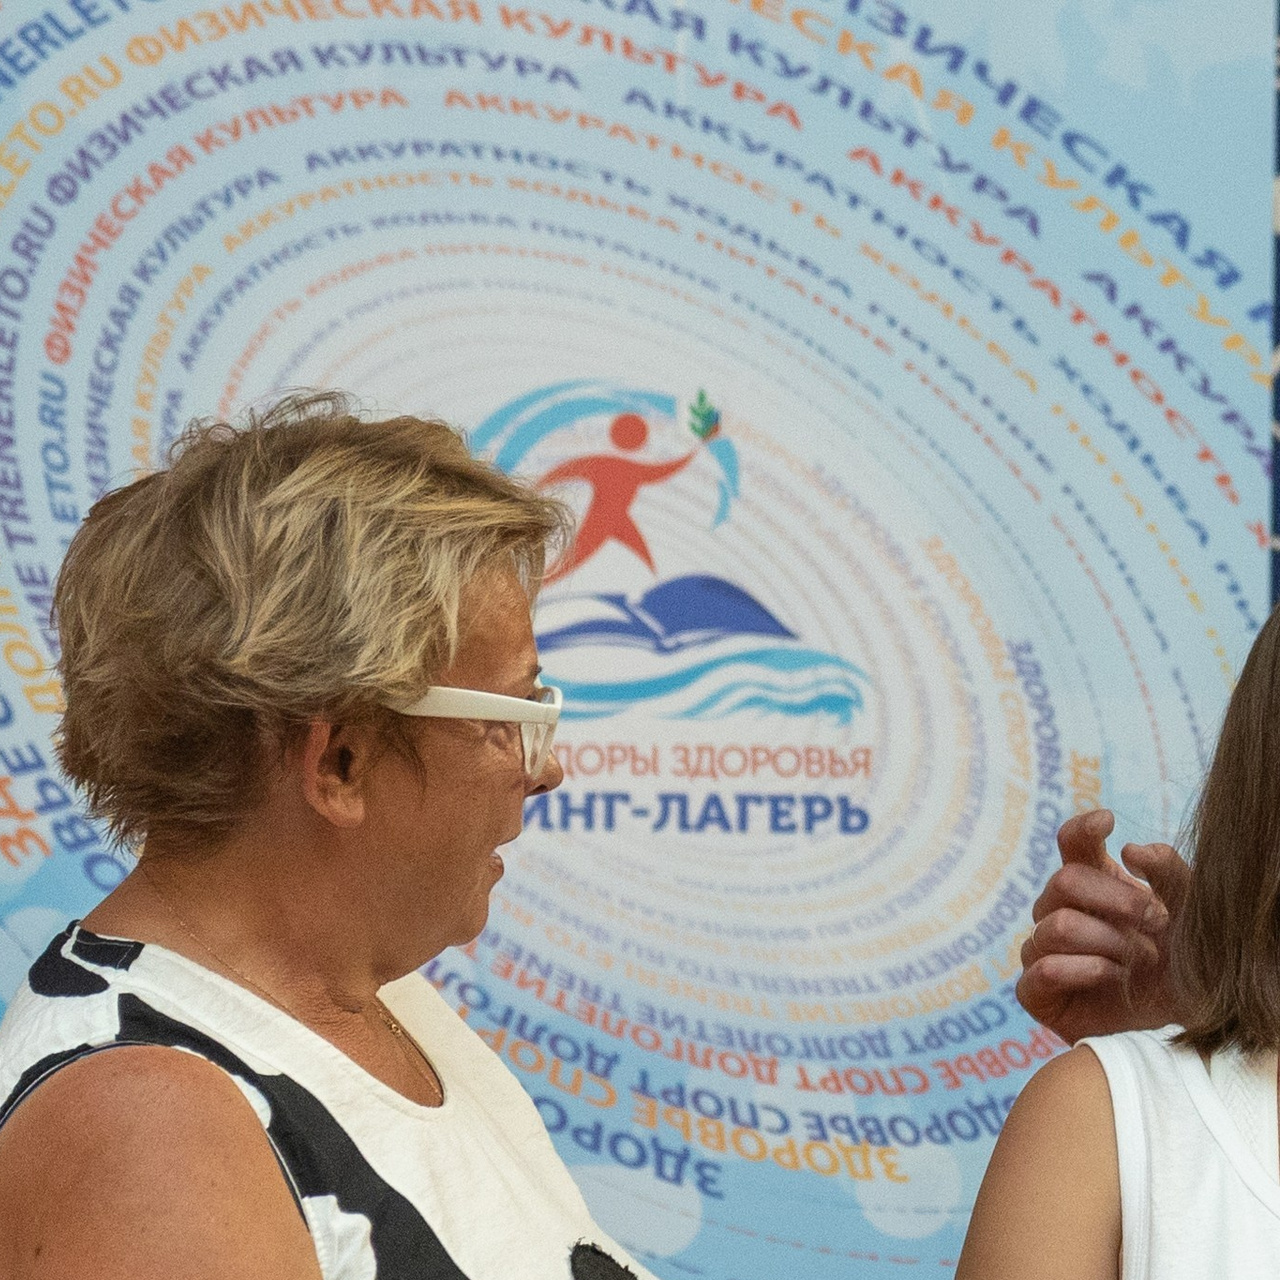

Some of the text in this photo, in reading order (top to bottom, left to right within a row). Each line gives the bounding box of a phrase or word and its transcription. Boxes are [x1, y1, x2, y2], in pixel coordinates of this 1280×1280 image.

[499, 5, 804, 133] КУЛЬТУРА
[193, 86, 410, 156] КУЛЬТУРА
[727, 26, 1041, 241] КУЛЬТУРА
[843, 0, 1245, 291] ЗИЧЕСКАЯ
[45, 52, 304, 207] ФИЗИЧЕСКАЯ
[307, 40, 583, 92] КУЛЬТУРА
[622, 85, 1041, 347] АККУРАТНОСТЬ
[43, 144, 197, 367] ФИЗИЧЕСКАЯ
[84, 282, 143, 501] ИЗИЧЕСКАЯ
[132, 166, 284, 285] КУЛЬТУРА
[38, 370, 82, 549] ETO.RU
[671, 742, 875, 782] ЗДОРОВЬЯ
[522, 791, 871, 835] ИНГ-ЛАГЕРЬ
[490, 952, 780, 1088] ДОЛГОЛЕТИЕ
[637, 999, 895, 1063] ДОЛГОЛЕТИЕ
[900, 997, 1009, 1057] СПОРТ
[628, 1067, 792, 1138] СПОРТ
[793, 1061, 932, 1098] СПОРТ
[799, 1092, 1018, 1149] ДОРОВЬЕ
[630, 1091, 912, 1185] ЗДОРОВЬЕ
